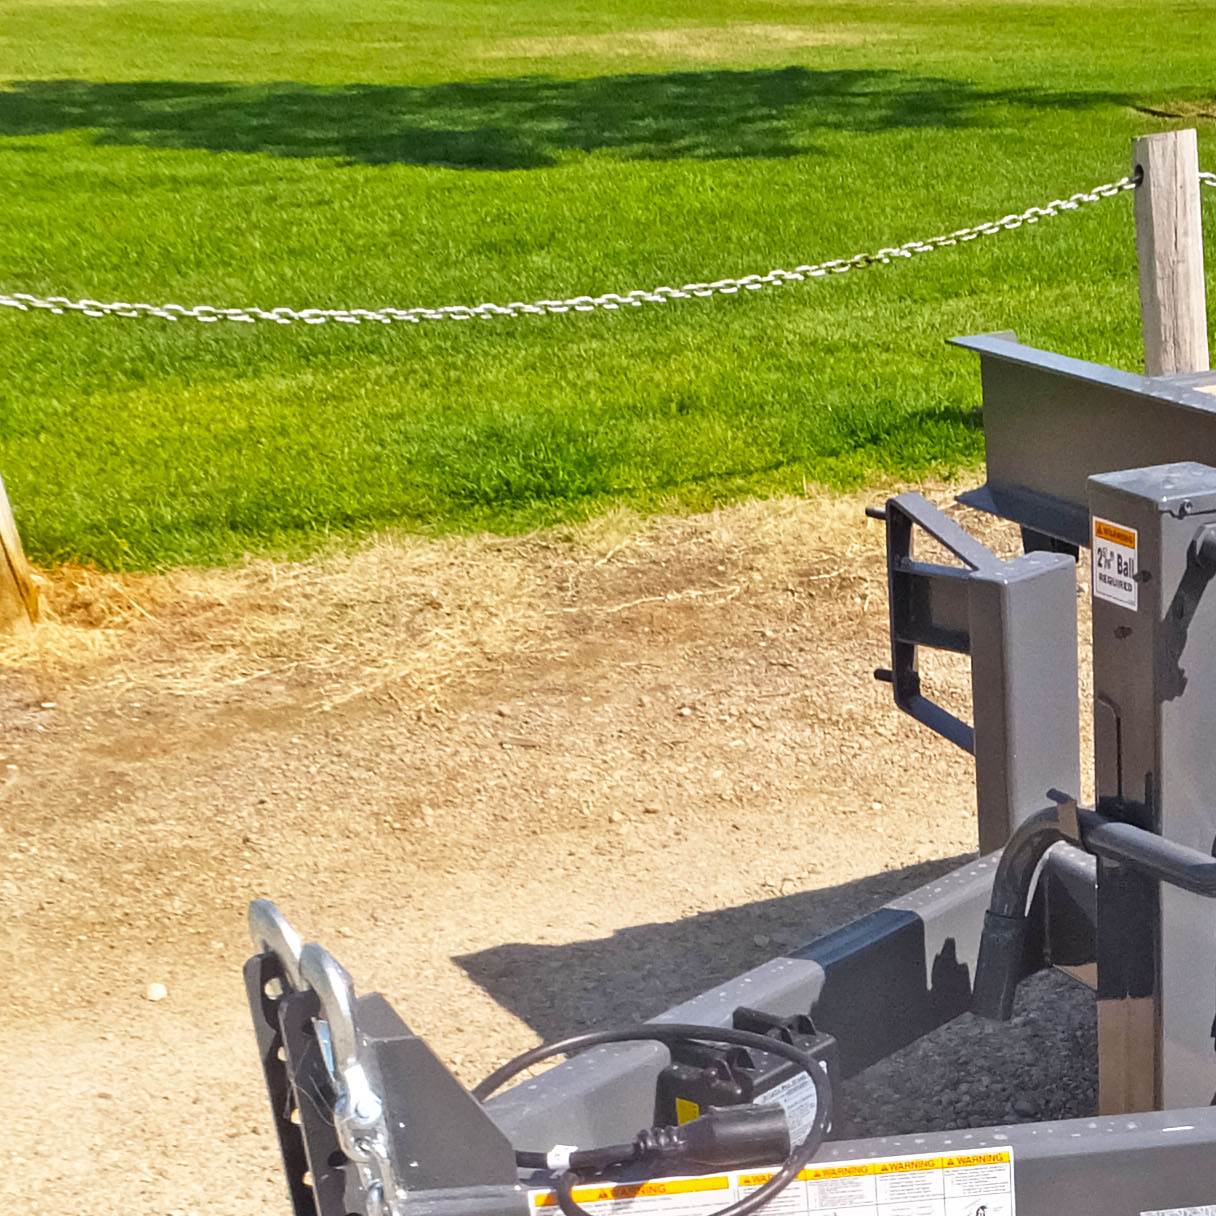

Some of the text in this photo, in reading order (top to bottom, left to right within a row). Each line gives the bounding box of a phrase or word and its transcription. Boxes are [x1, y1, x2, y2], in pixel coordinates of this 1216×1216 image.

[1117, 554, 1135, 577] Ball
[1098, 573, 1133, 592] REQUIRED
[888, 1159, 935, 1171] WARNING
[956, 1152, 1004, 1165] WARNING
[822, 1166, 869, 1177] WARNING
[610, 1184, 667, 1199] WARNING
